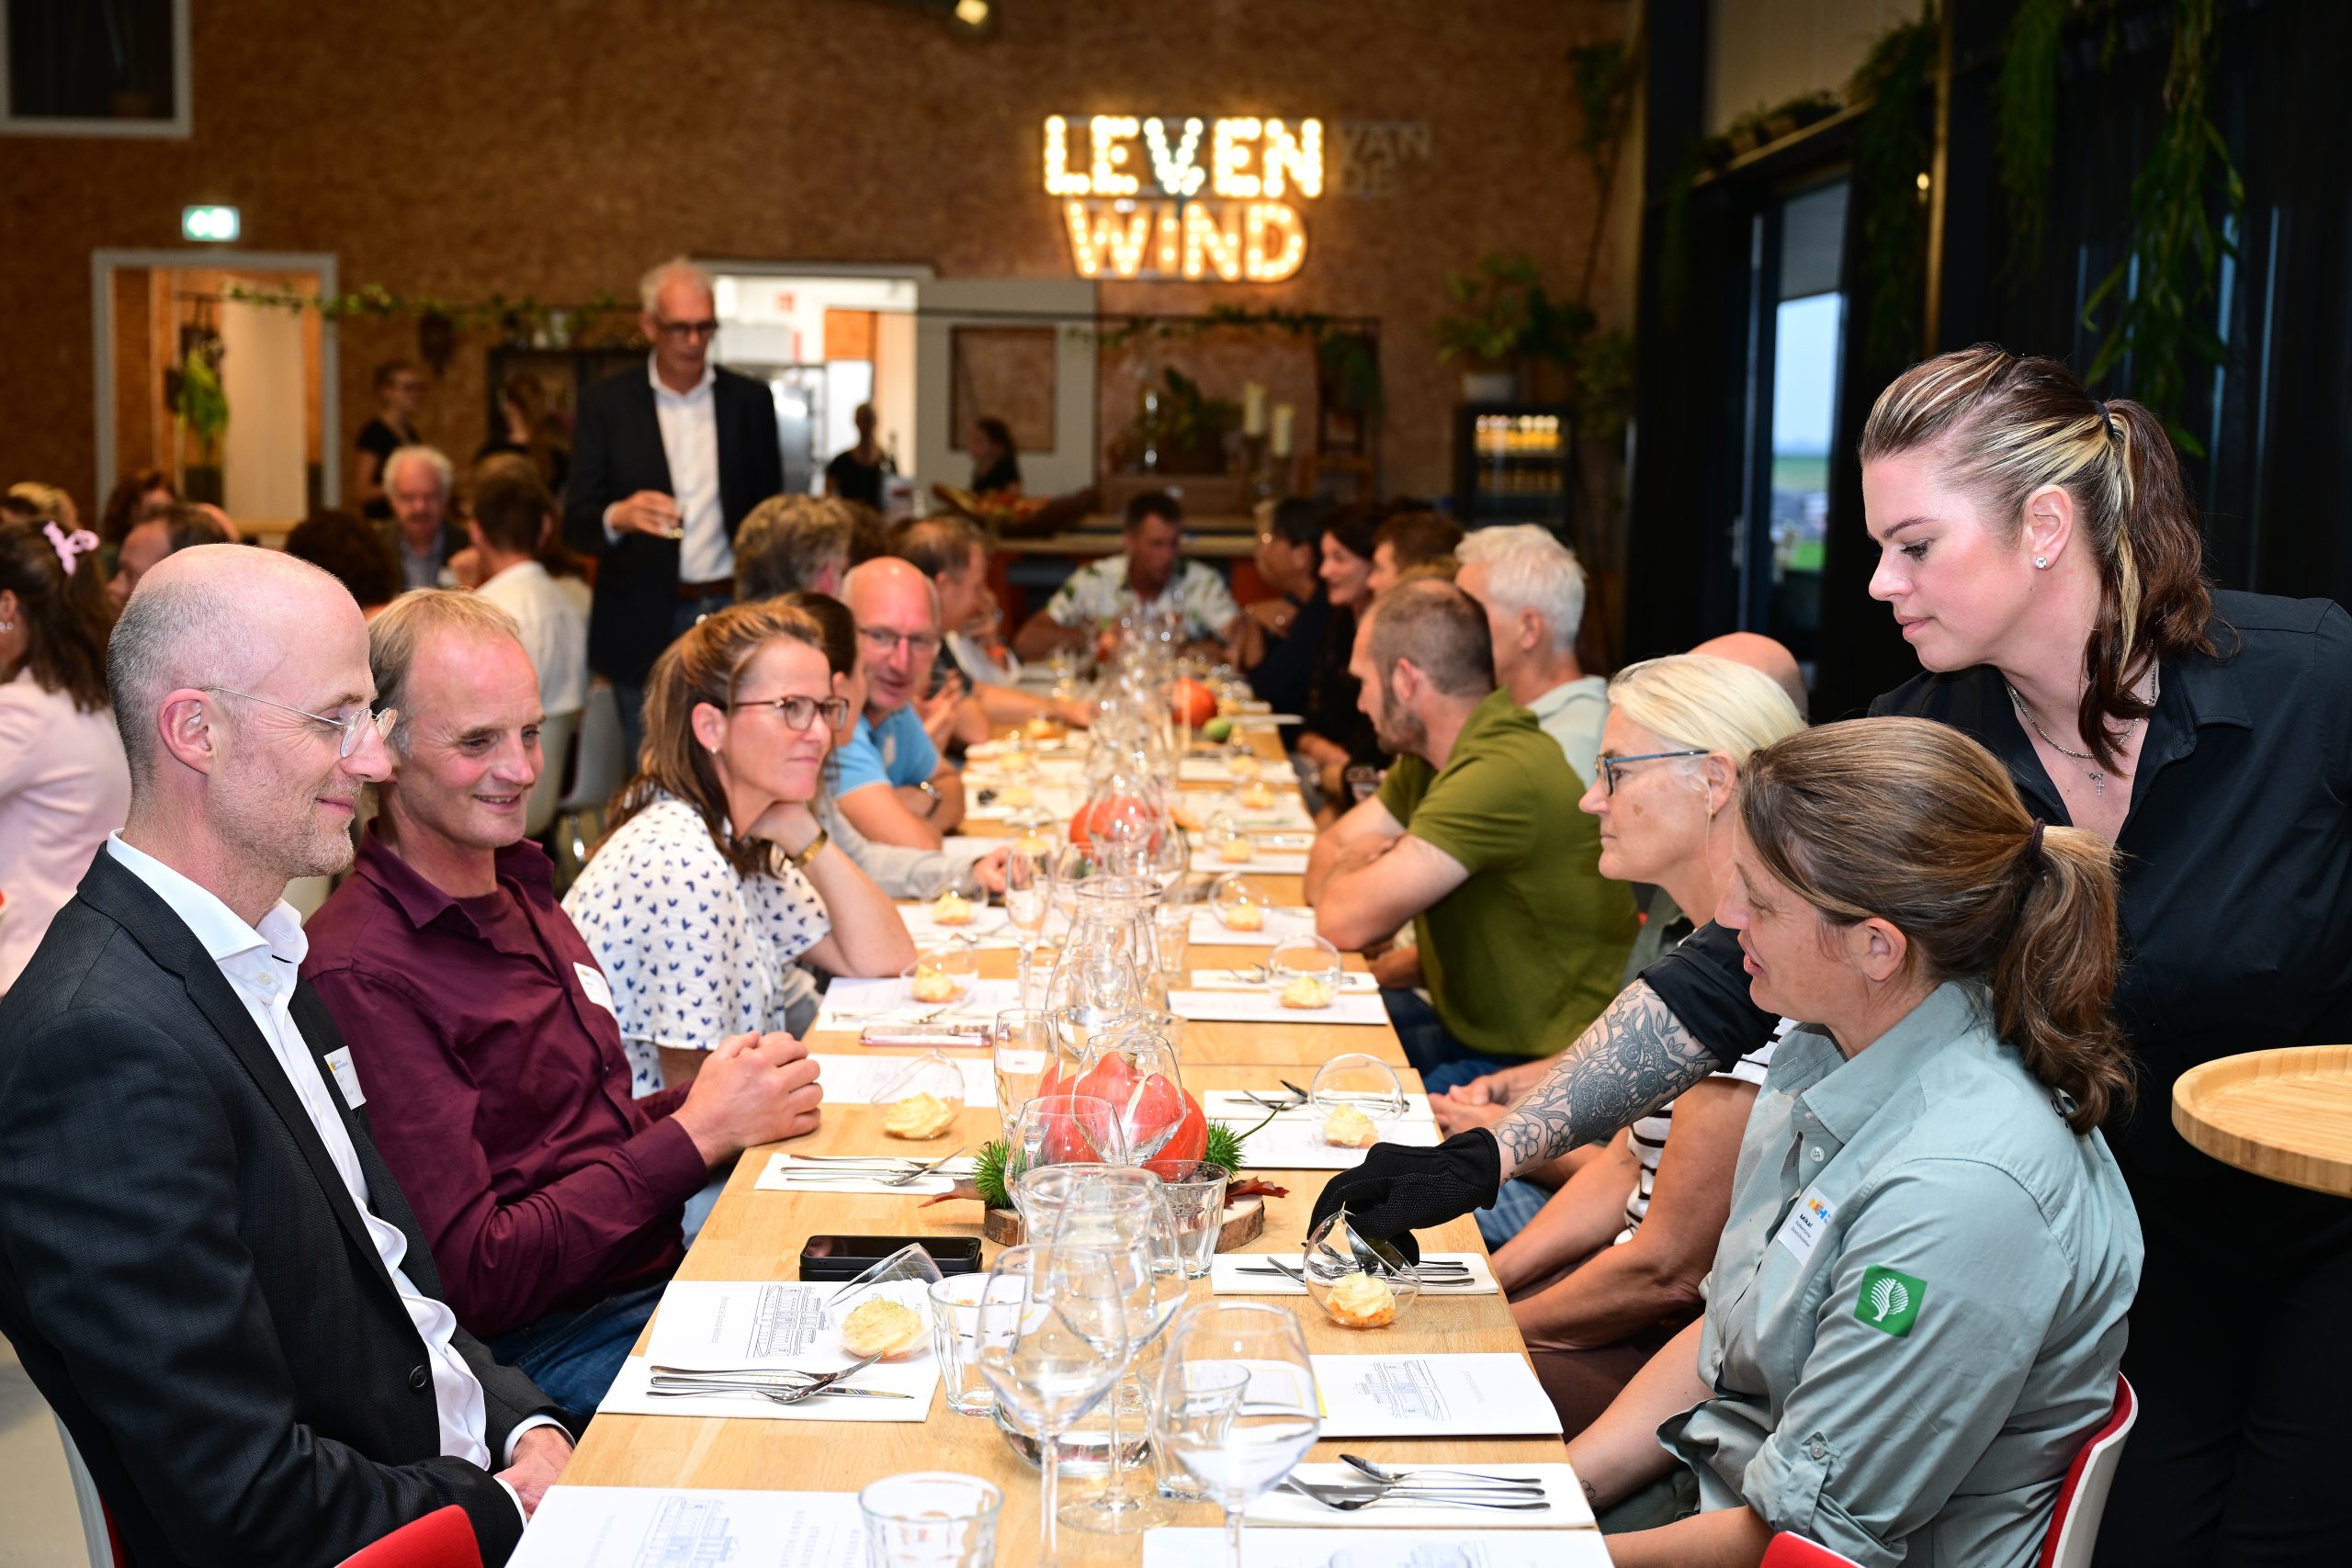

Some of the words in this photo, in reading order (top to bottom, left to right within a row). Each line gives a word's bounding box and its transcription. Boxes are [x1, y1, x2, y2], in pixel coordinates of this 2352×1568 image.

[1043, 114, 1325, 199] LEVEN
[1329, 120, 1432, 168] VAN
[1063, 199, 1309, 284] WIND
